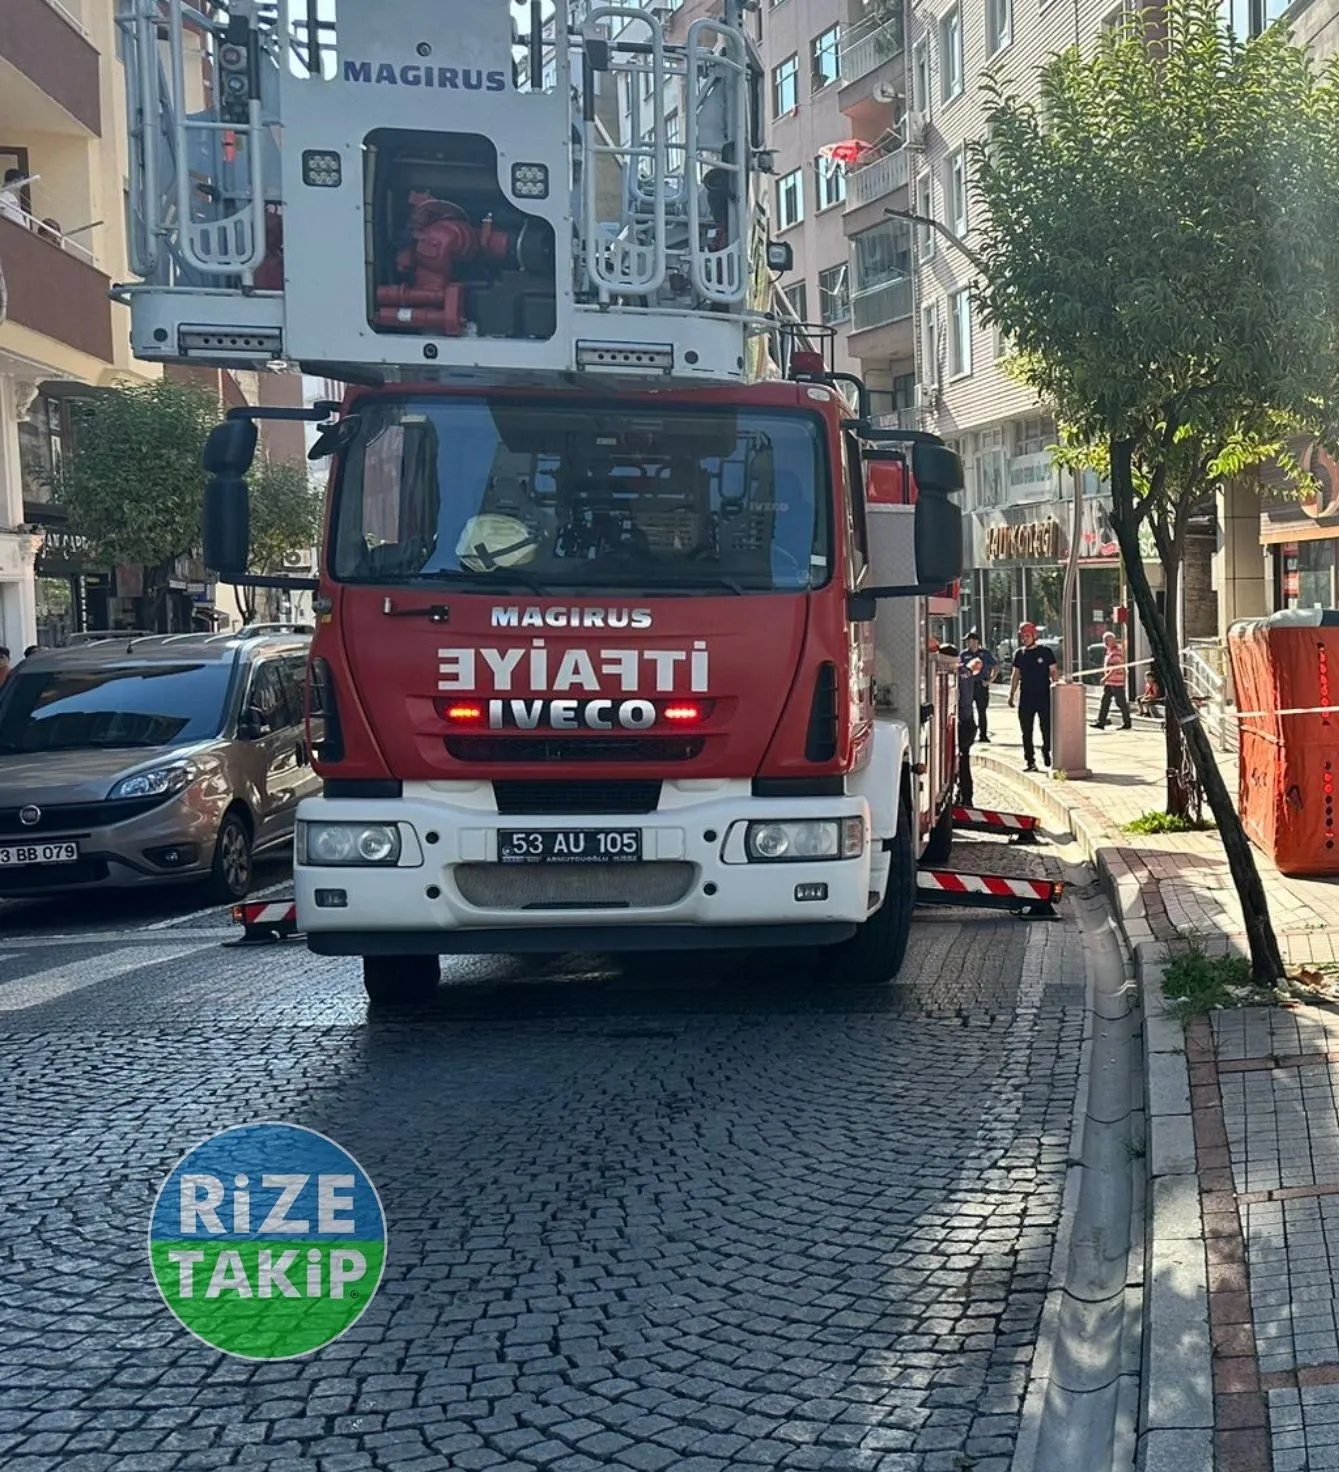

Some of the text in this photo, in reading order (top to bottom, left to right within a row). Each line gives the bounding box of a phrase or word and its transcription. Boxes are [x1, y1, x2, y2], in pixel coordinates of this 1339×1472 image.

[343, 60, 506, 92] MAGIRUS
[491, 606, 653, 629] MAGIRUS
[488, 699, 657, 730] IVECO
[16, 848, 39, 862] BB
[43, 844, 76, 860] 079
[513, 832, 637, 854] 53 AU 105
